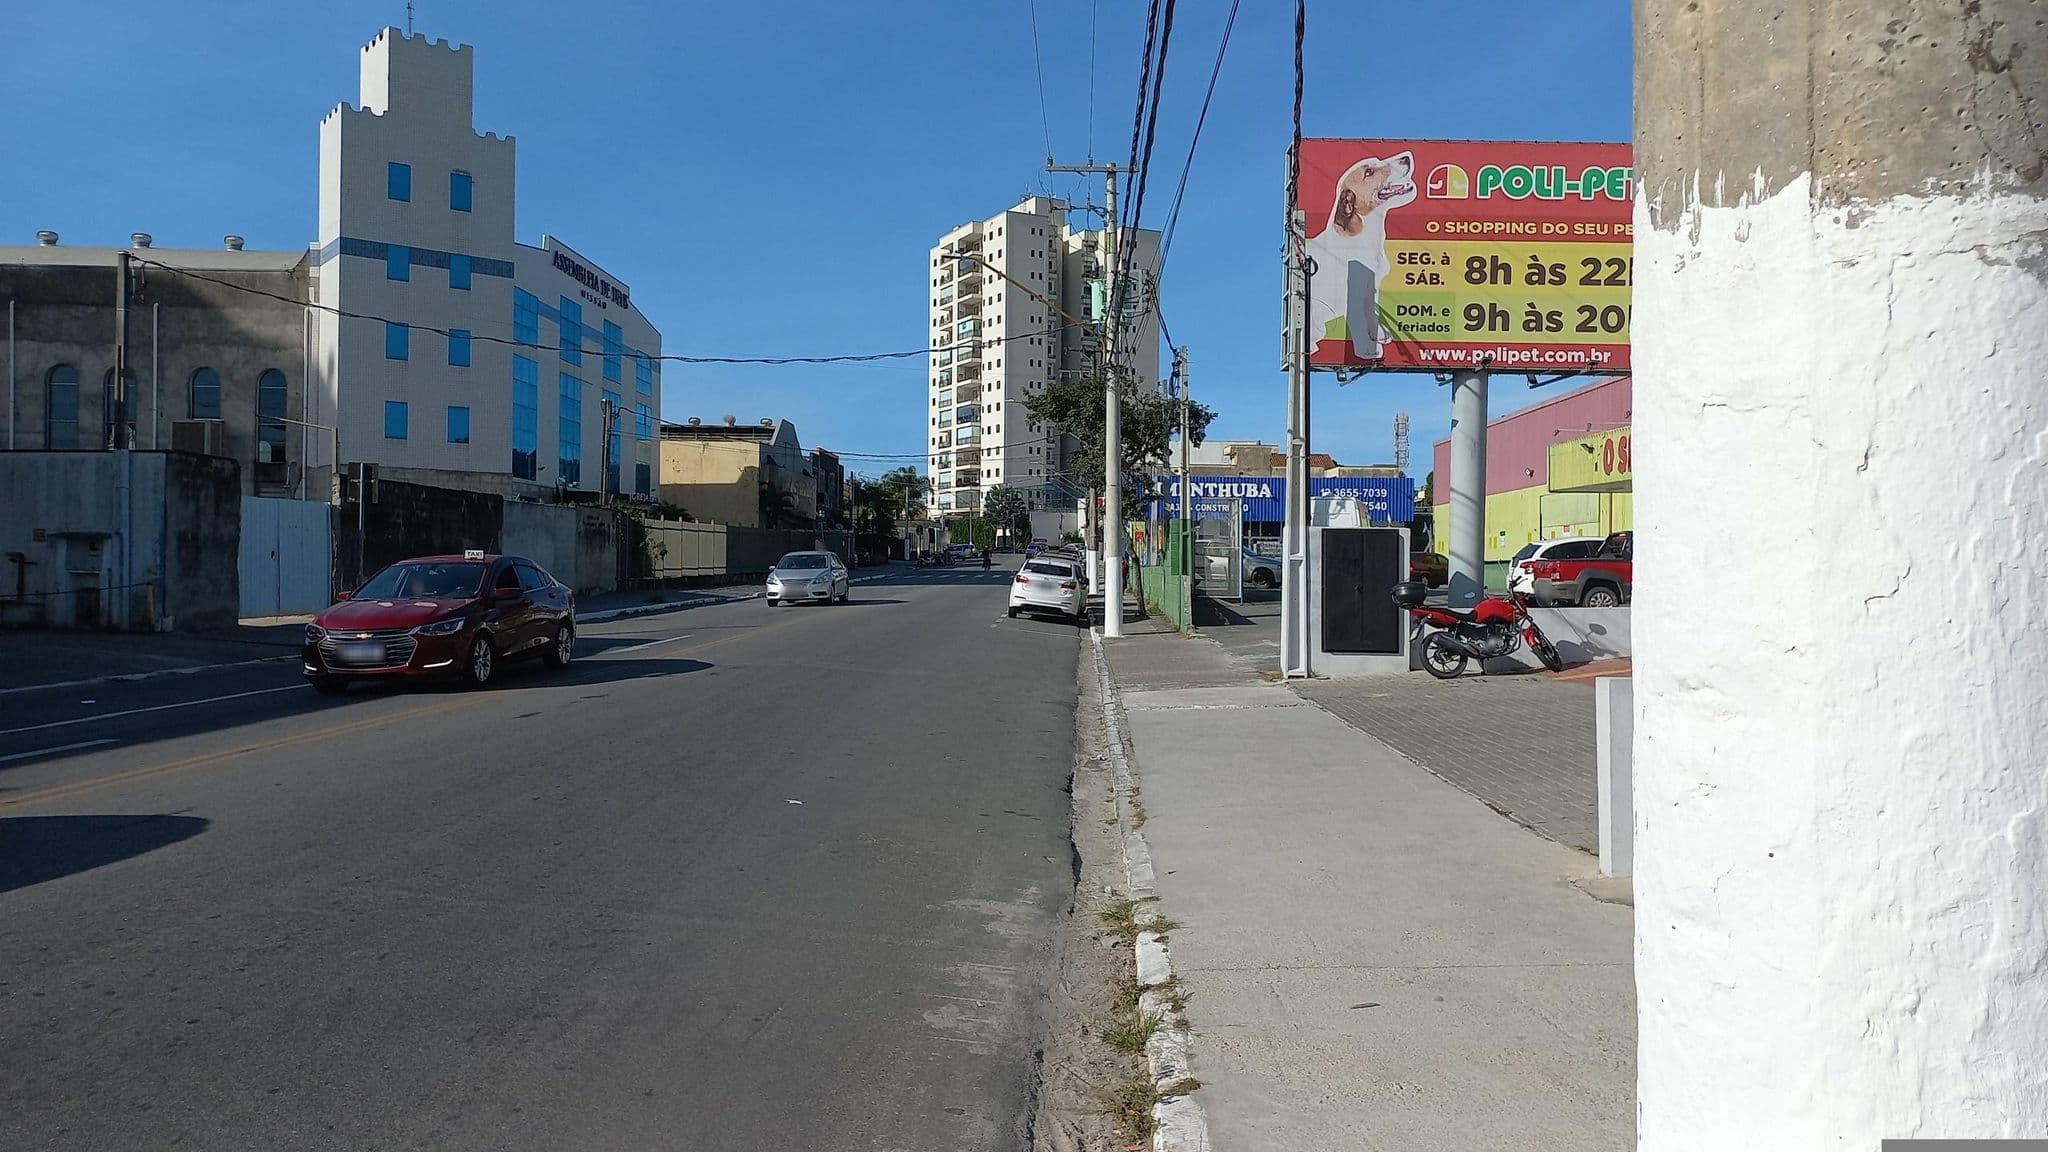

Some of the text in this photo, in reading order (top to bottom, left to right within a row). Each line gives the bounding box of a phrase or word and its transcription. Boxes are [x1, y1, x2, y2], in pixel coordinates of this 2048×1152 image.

[1426, 221, 1633, 236] O SHOPPING DO SEU PE
[1396, 252, 1451, 266] SEG. à
[1404, 268, 1445, 285] SÁB.
[1464, 255, 1512, 286] 8h
[1525, 254, 1567, 286] às
[1396, 304, 1451, 317] DOM. e
[1463, 301, 1632, 334] 9h às 20
[1397, 321, 1451, 333] feriados
[1419, 347, 1611, 366] www.polipet.com.br
[1603, 435, 1631, 475] O S
[1334, 488, 1387, 498] 3655-7039
[1195, 503, 1249, 512] CONSTRO
